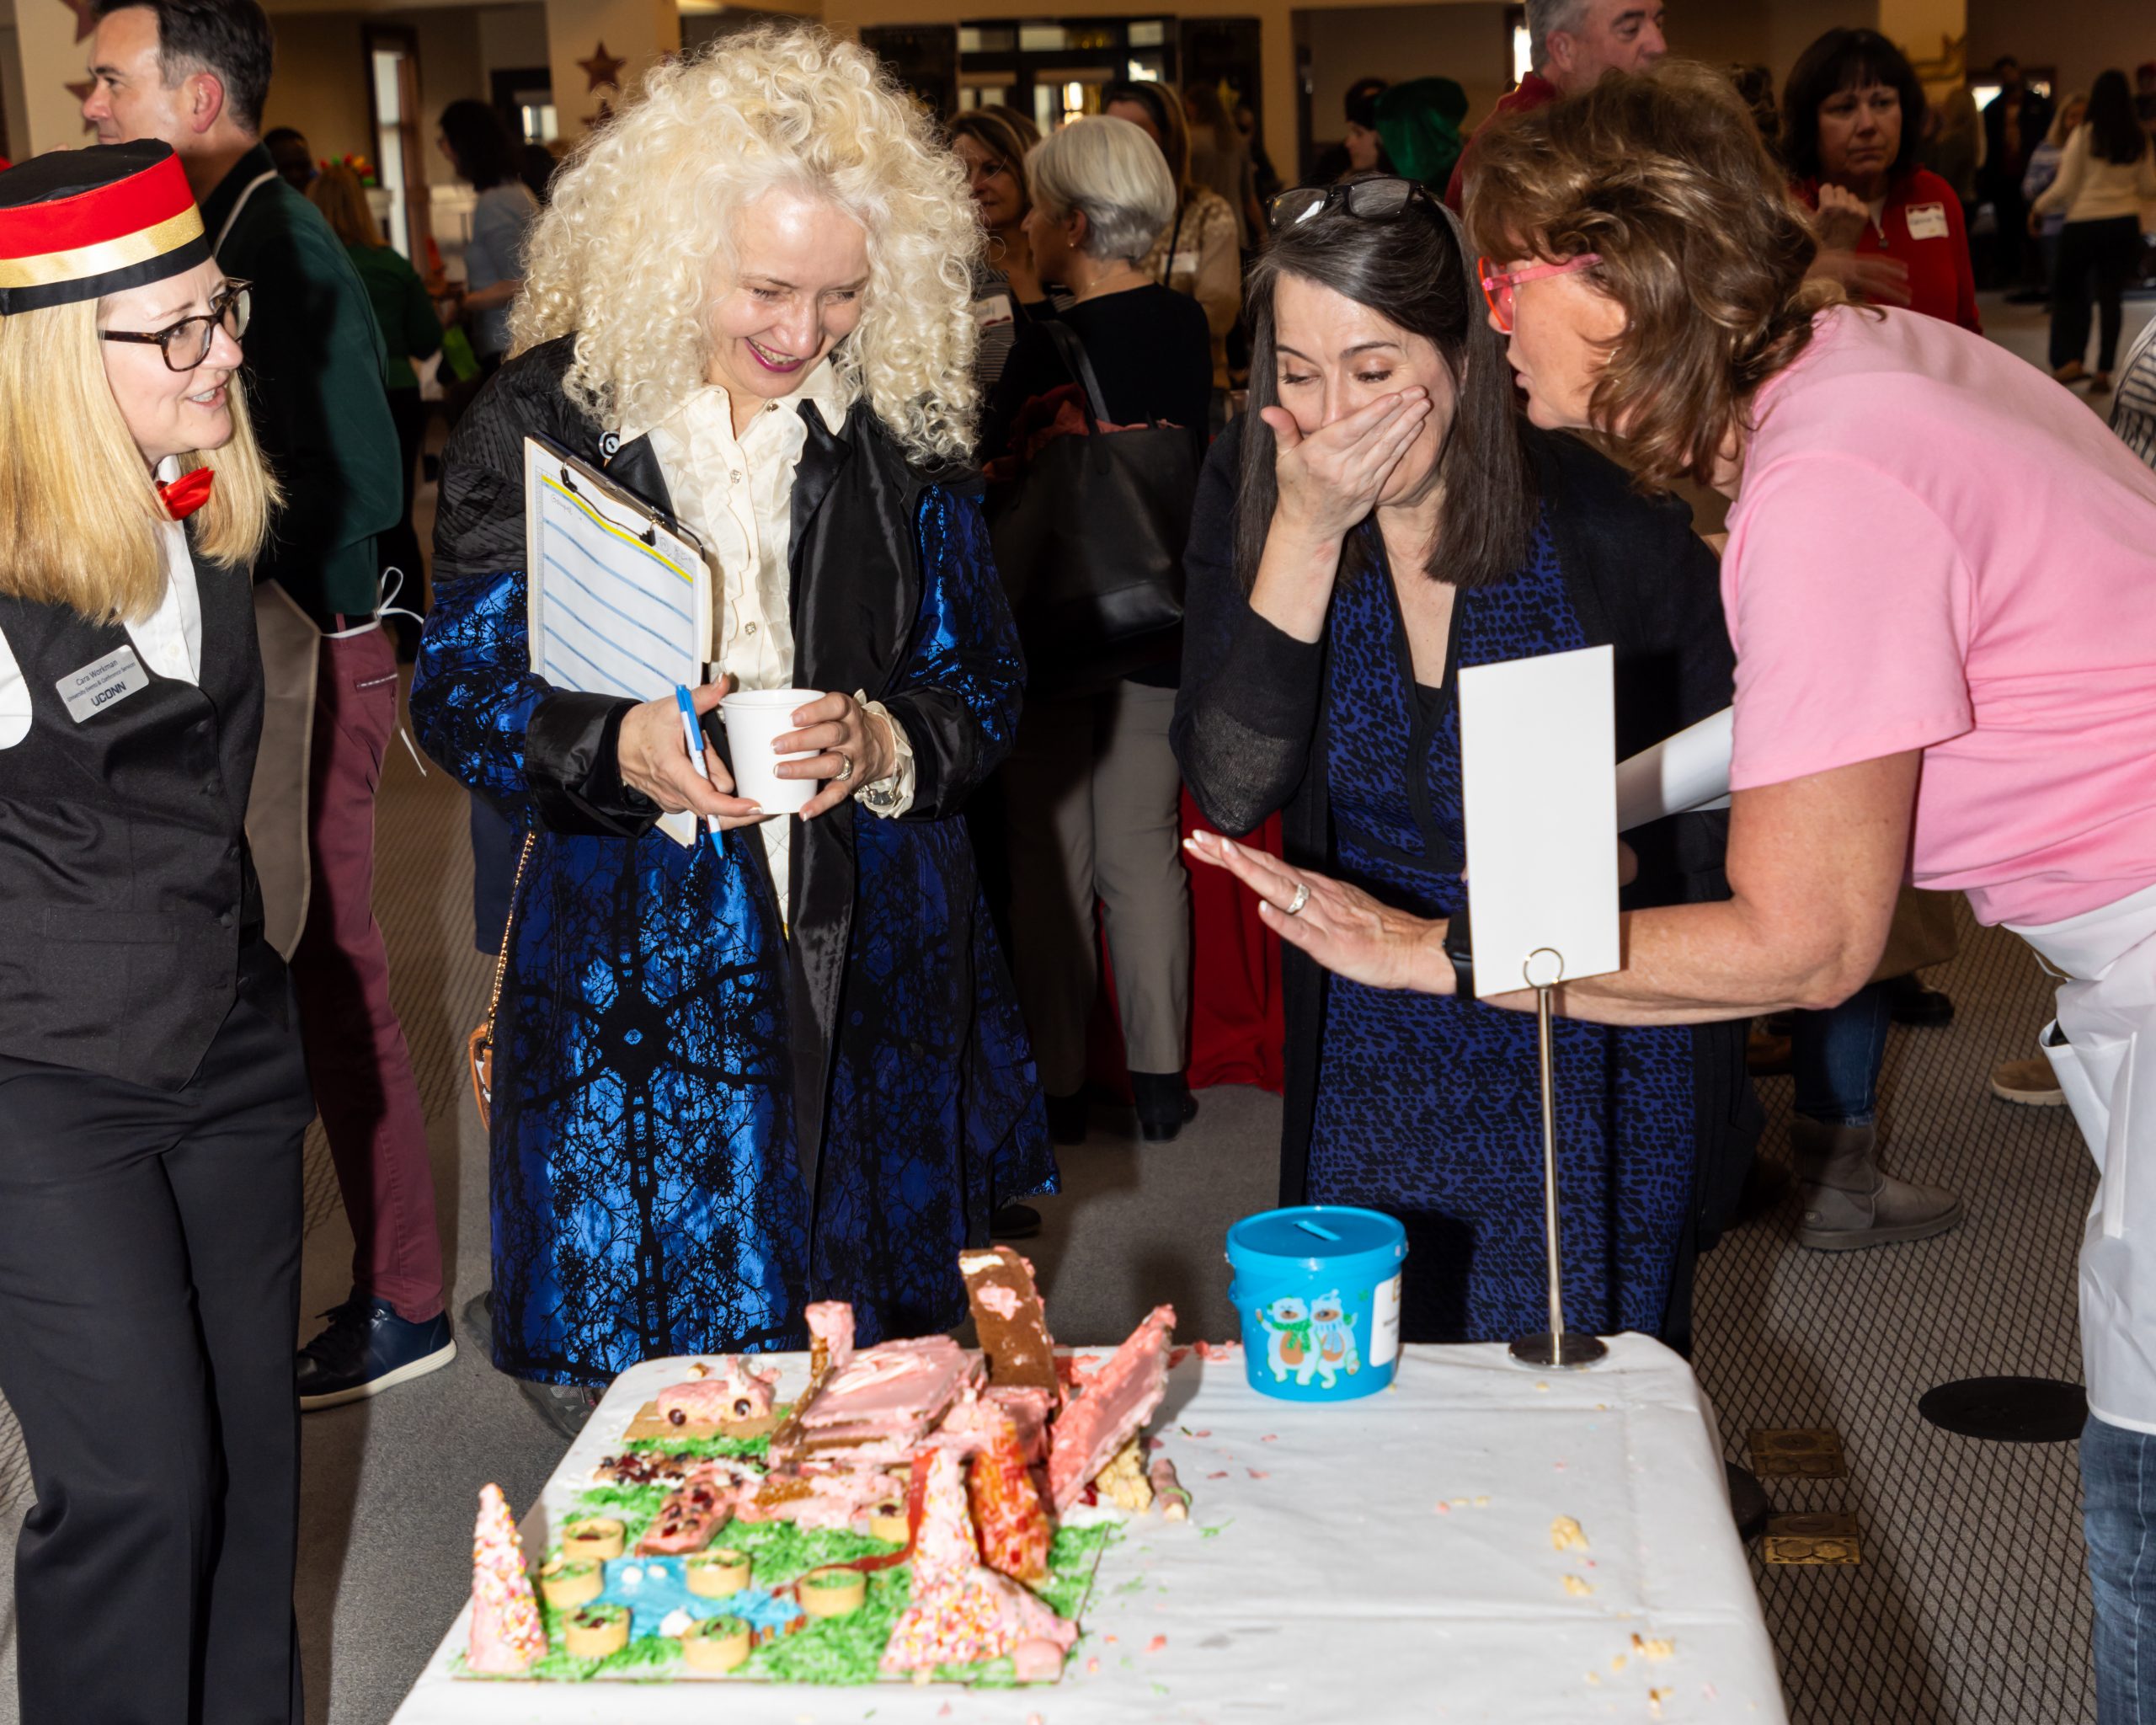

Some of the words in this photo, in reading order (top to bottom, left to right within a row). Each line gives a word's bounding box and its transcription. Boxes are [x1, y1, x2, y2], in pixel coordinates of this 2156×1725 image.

[76, 676, 90, 686] Cara
[89, 660, 118, 678] Workman
[90, 681, 127, 707] UCONN
